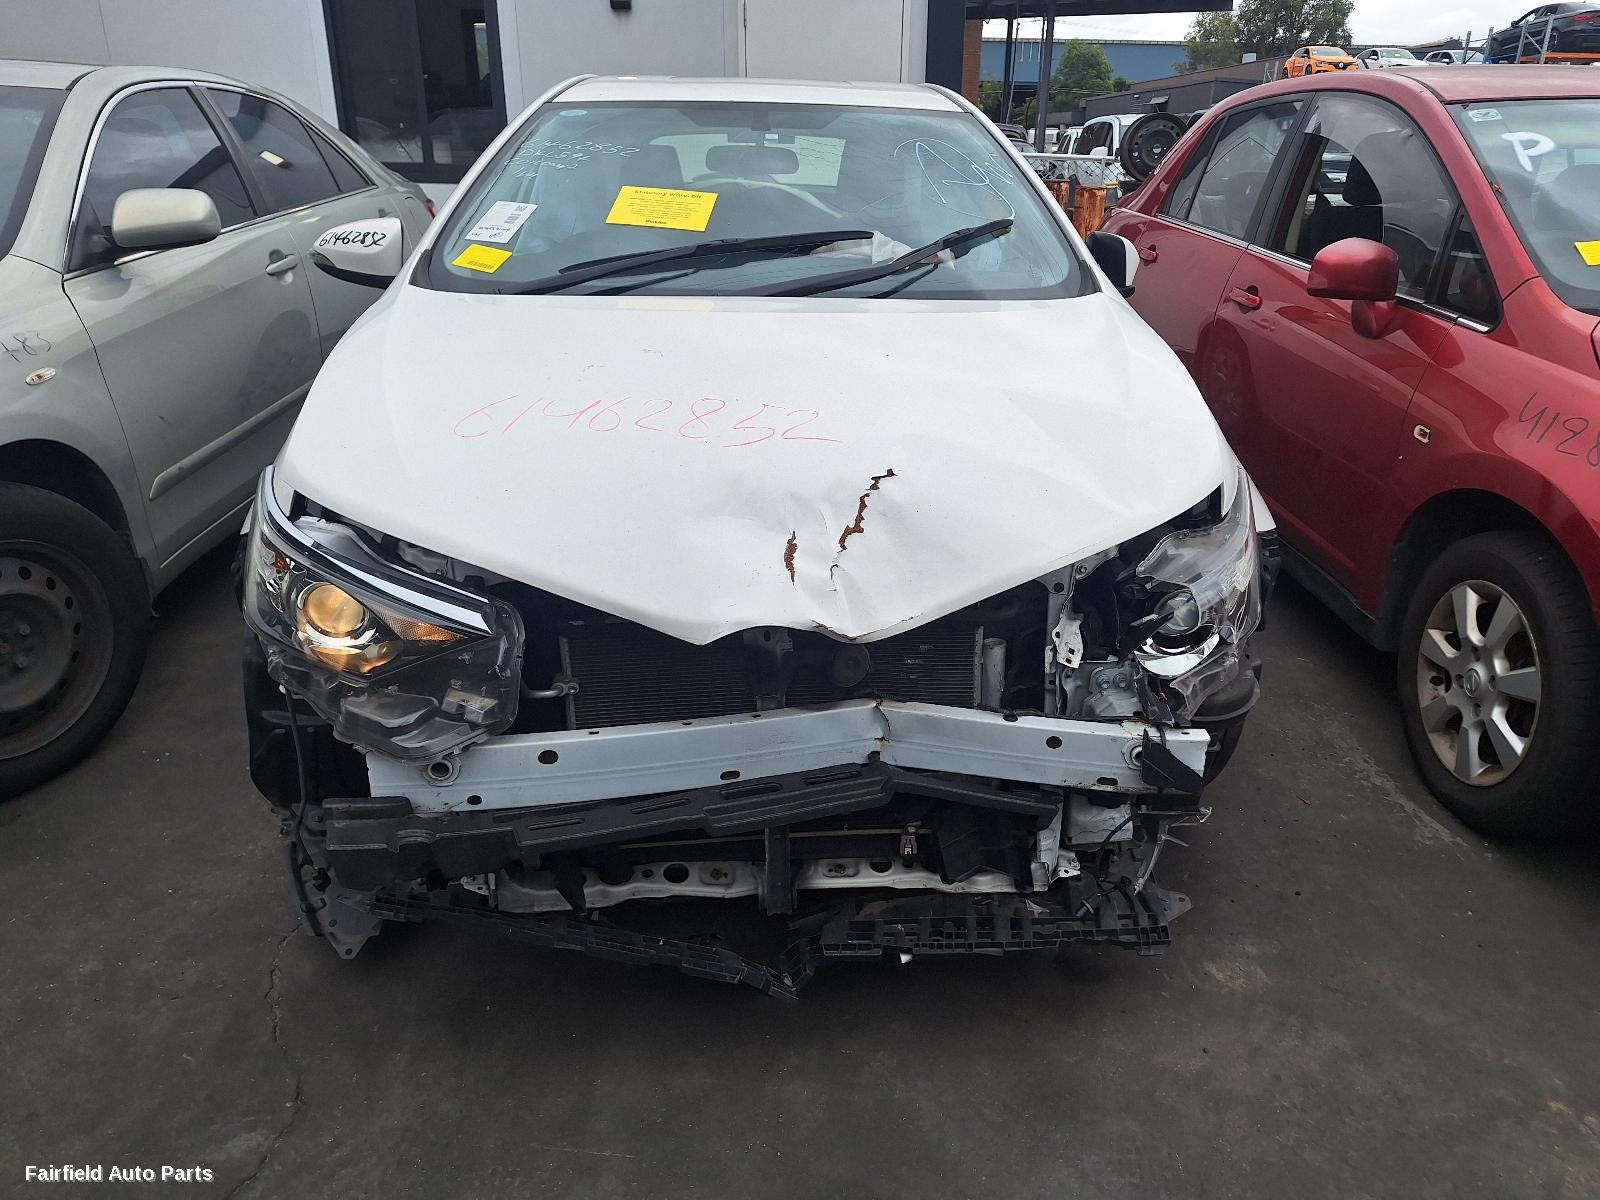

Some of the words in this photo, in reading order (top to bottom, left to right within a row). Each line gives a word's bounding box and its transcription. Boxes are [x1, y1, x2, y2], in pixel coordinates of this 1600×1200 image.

[1501, 131, 1556, 172] P
[319, 231, 387, 248] 61462852
[454, 395, 844, 448] 61462852
